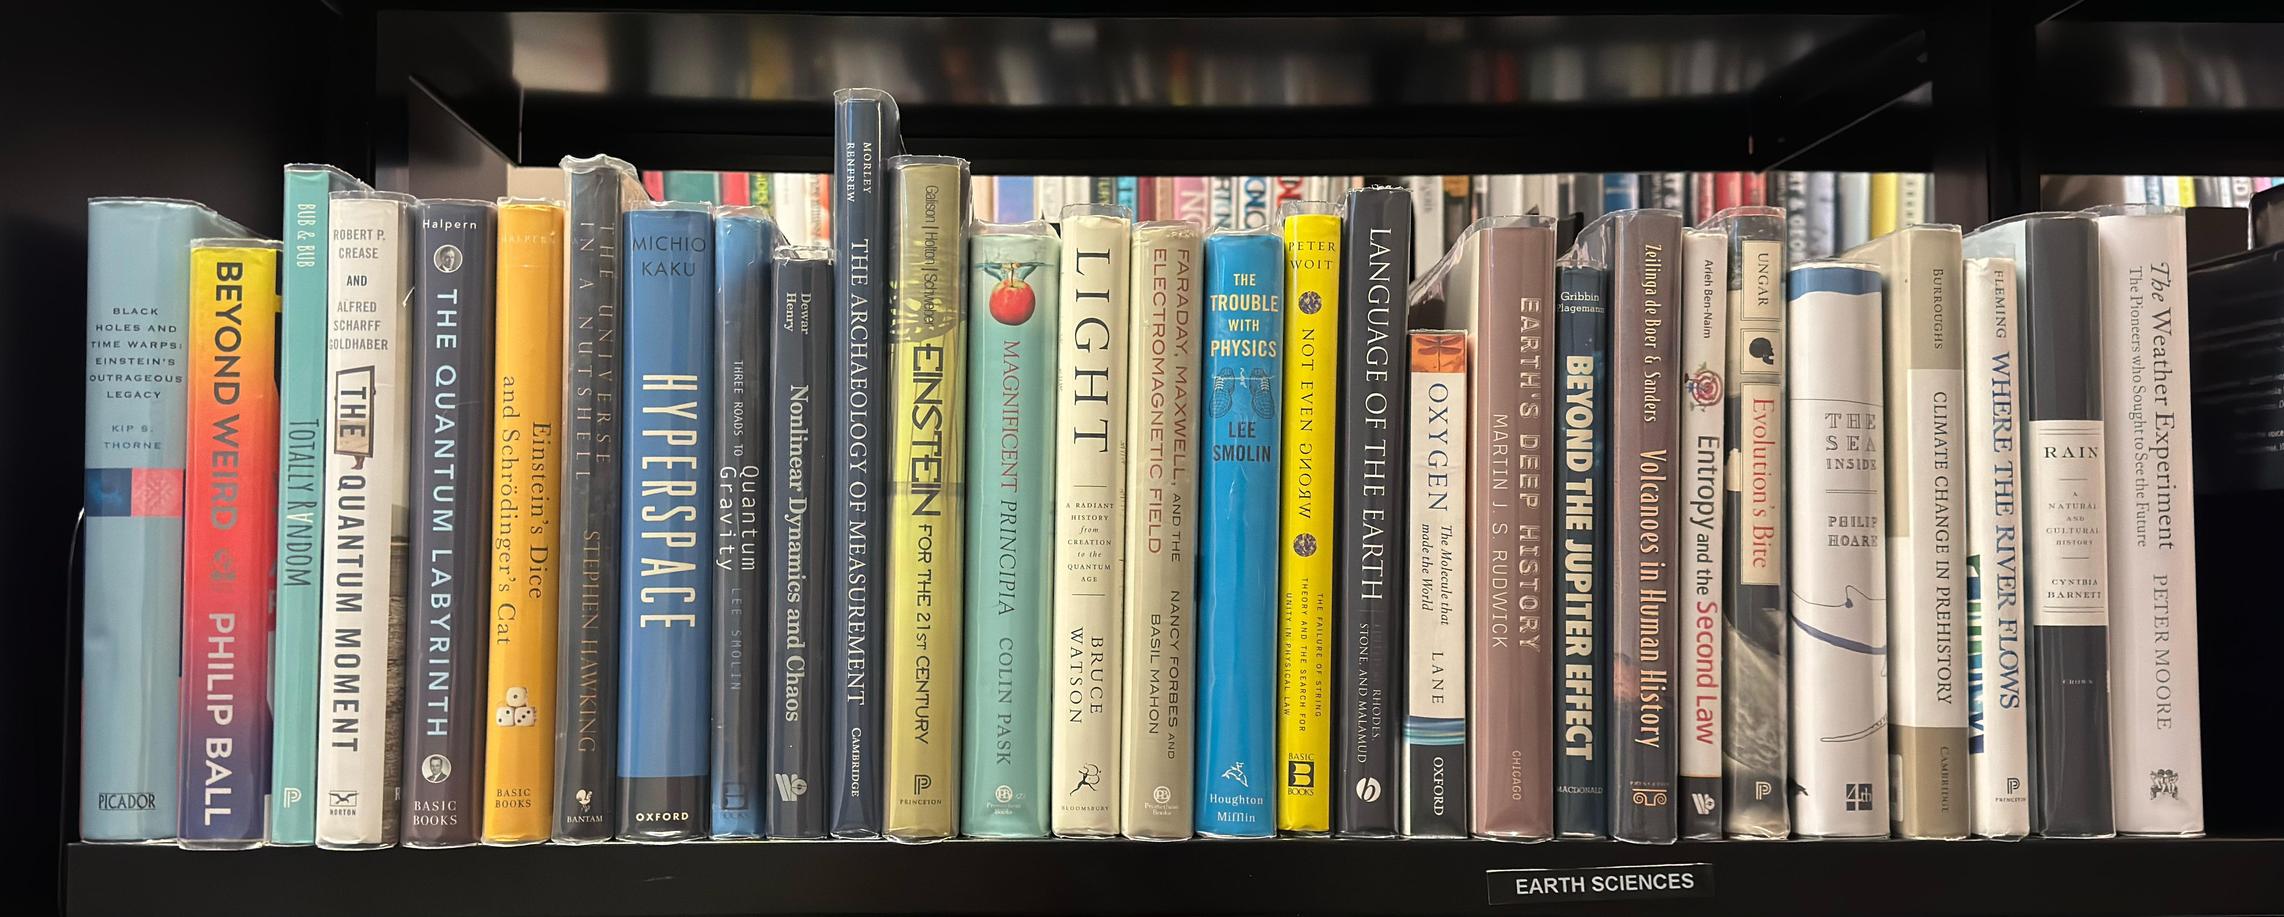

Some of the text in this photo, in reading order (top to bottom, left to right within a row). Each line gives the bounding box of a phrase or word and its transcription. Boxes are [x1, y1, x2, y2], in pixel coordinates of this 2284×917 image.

[846, 142, 855, 203] RENFREW
[863, 142, 872, 194] MORLEY
[422, 219, 477, 230] Halpern
[632, 236, 706, 252] MICHIO
[1288, 241, 1336, 251] PETER
[338, 247, 378, 259] CREASE
[642, 262, 696, 277] KAKU
[1290, 260, 1333, 270] WOIT
[346, 275, 368, 287] AND
[1210, 294, 1278, 312] TROUBLE
[1233, 273, 1256, 286] THE
[1560, 291, 1600, 302] Gribbin
[1757, 253, 1768, 306] UNGAR
[1994, 270, 2006, 339] FLEMING
[96, 324, 177, 333] HOLES AND
[112, 307, 158, 315] BLACK
[333, 320, 382, 331] SCHARFF
[337, 301, 377, 313] ALFRED
[1228, 319, 1259, 331] WITH
[1933, 269, 1944, 349] BURROUGHS
[90, 340, 183, 350] TIME WARPS:
[95, 356, 176, 366] EINSTEIN'S
[329, 338, 389, 350] GOLDHABER
[576, 223, 595, 480] IN A NUTSHELL
[596, 226, 614, 463] THE UNIVERSE
[1073, 247, 1111, 454] LIGHT
[1210, 340, 1277, 358] PHYSICS
[1301, 329, 1314, 371] NOT
[89, 374, 183, 383] OUTRAGEOUS
[106, 390, 162, 399] LEGACY
[209, 262, 243, 531] BEYOND WEIRD
[1148, 249, 1167, 554] ELECTROMAGNETIC FIELD
[911, 343, 943, 516] EINSTEIN
[1171, 249, 1190, 562] FARADAY, MAXWELL, AND THE
[1229, 422, 1256, 438] LEE
[1300, 382, 1313, 432] EVEN
[1361, 227, 1392, 600] LANGUAGE OF THE EARTH
[1825, 413, 1876, 429] THE
[2129, 266, 2149, 547] The Pioneers who Sought to See the Future
[2150, 262, 2175, 550] The Weather Experiment
[104, 441, 162, 450] THORNE
[287, 418, 319, 492] TOTALLY
[1213, 446, 1271, 463] SMOLIN
[1427, 383, 1449, 512] OXYGEN
[1826, 436, 1876, 451] SEA
[1826, 458, 1876, 470] INSIDE
[2045, 446, 2098, 458] RAIN
[847, 239, 869, 705] THE ARCHAEOLOGY OF MEASUREMENT
[998, 340, 1020, 616] MAGNIFICENT PRINCIPIA
[1518, 297, 1542, 652] EARTH'S DEEP HISTORY
[1752, 398, 1776, 568] Evolution's Bite
[426, 289, 458, 736] THE QUANTUM LABYRINTH
[496, 376, 521, 645] and Schrödinger's Cat
[529, 421, 552, 599] Einstein's Dice
[640, 374, 698, 628] HYPERSPACE
[716, 466, 738, 571] Gravity
[739, 465, 760, 571] Quantum
[1828, 516, 1878, 528] PHILIP
[784, 384, 810, 722] Nonlinear Dynamics and Chaos
[917, 524, 932, 564] FOR
[1828, 535, 1878, 546] HOARE
[1934, 391, 1951, 704] CLIMATE CHANGE IN PREHISTORY
[1992, 352, 2020, 710] WHERE THE RIVER FLOWS
[332, 386, 367, 752] THE QUANTUM MOMENT
[1422, 524, 1433, 611] made the World
[1440, 524, 1452, 624] The Molecule that
[1565, 355, 1594, 760] BEYOND THE JUPITER EFFECT
[917, 568, 931, 607] THE
[1634, 449, 1667, 748] Volcanoes in Human History
[1690, 434, 1720, 745] Entropy and the Second Law
[578, 531, 600, 752] STEPHEN HAWKING
[2153, 575, 2172, 730] PETER MOORE
[914, 656, 931, 745] CENTURY
[1069, 627, 1084, 724] WATSON
[1090, 636, 1103, 715] BRUCE
[1432, 652, 1444, 704] LANE
[204, 613, 235, 827] PHILIP BALL
[98, 792, 156, 810] PICADOR
[413, 800, 457, 812] BASIC
[1210, 793, 1264, 806] Houghton
[1433, 757, 1444, 816] OXFORD
[412, 814, 458, 826] BOOKS
[636, 811, 689, 822] OXFORD
[1217, 811, 1256, 822] Mifflin
[1516, 874, 1694, 895] EARTH SCIENCES
